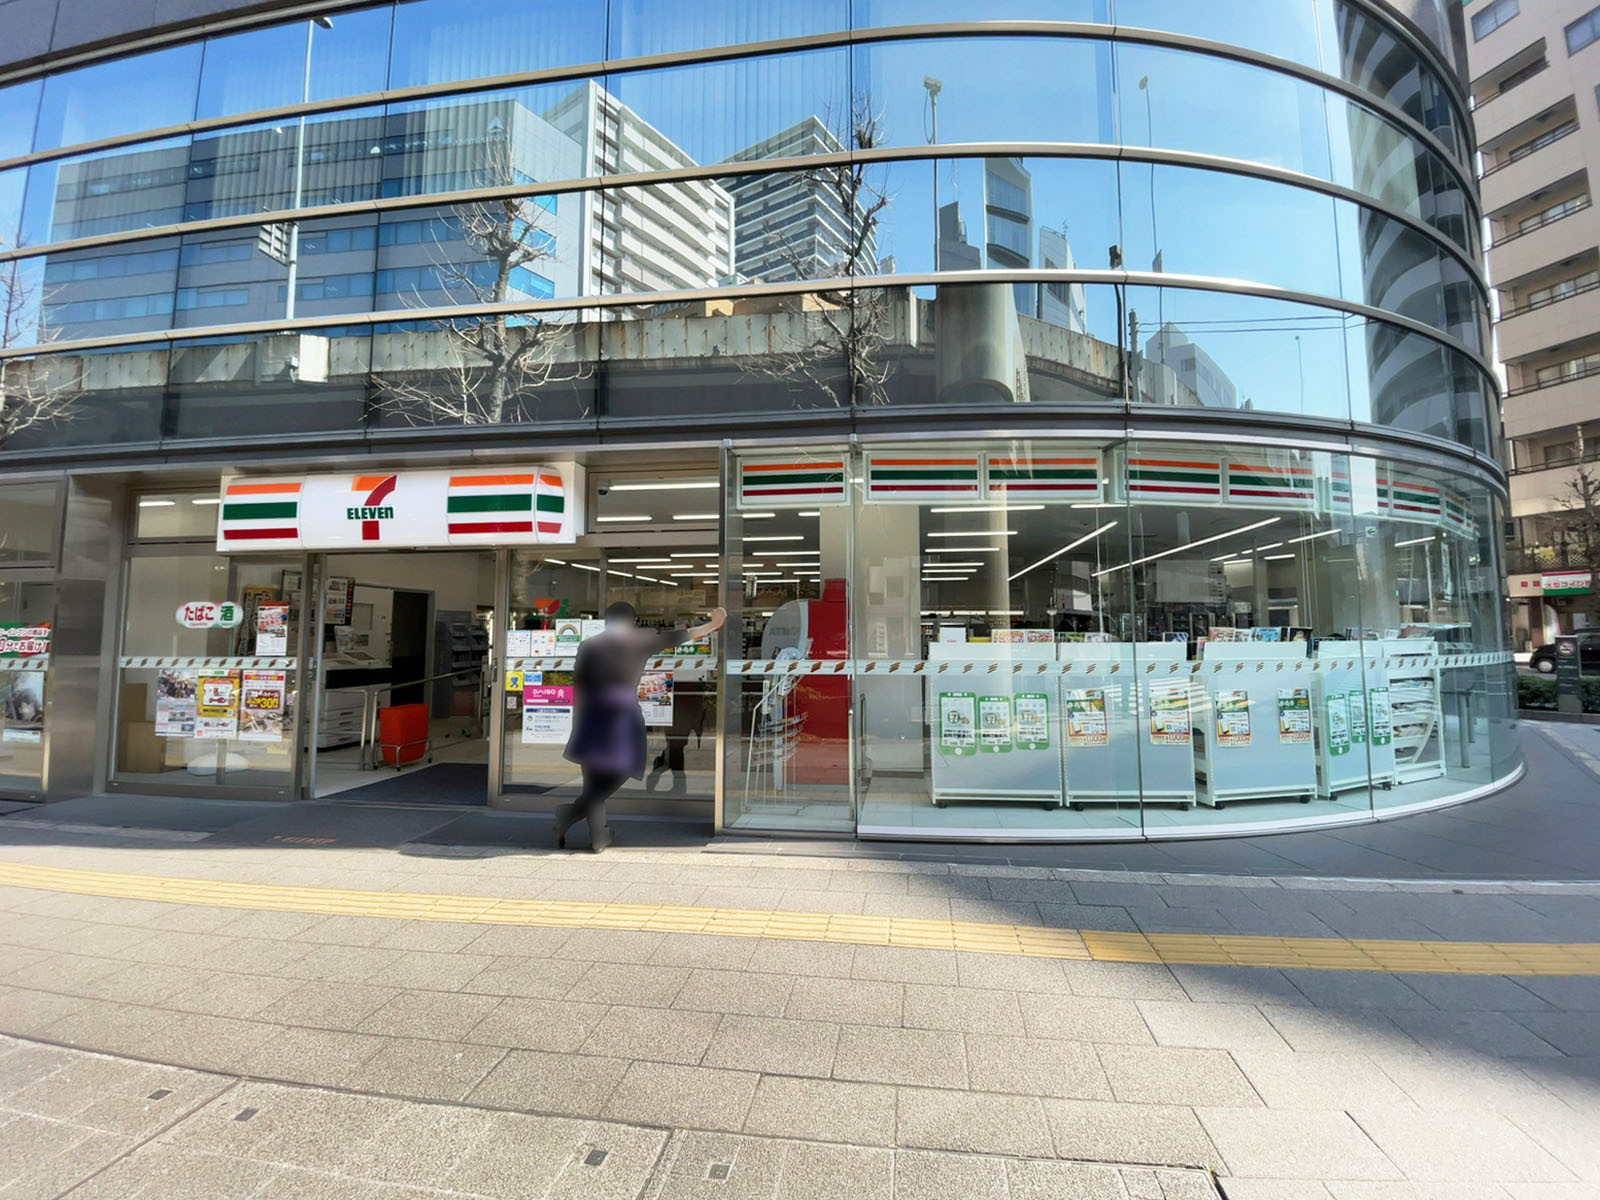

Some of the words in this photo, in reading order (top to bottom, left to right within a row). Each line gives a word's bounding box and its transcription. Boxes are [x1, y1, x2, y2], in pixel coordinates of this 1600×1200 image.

[184, 605, 214, 622] たばこ
[220, 605, 234, 621] 酒
